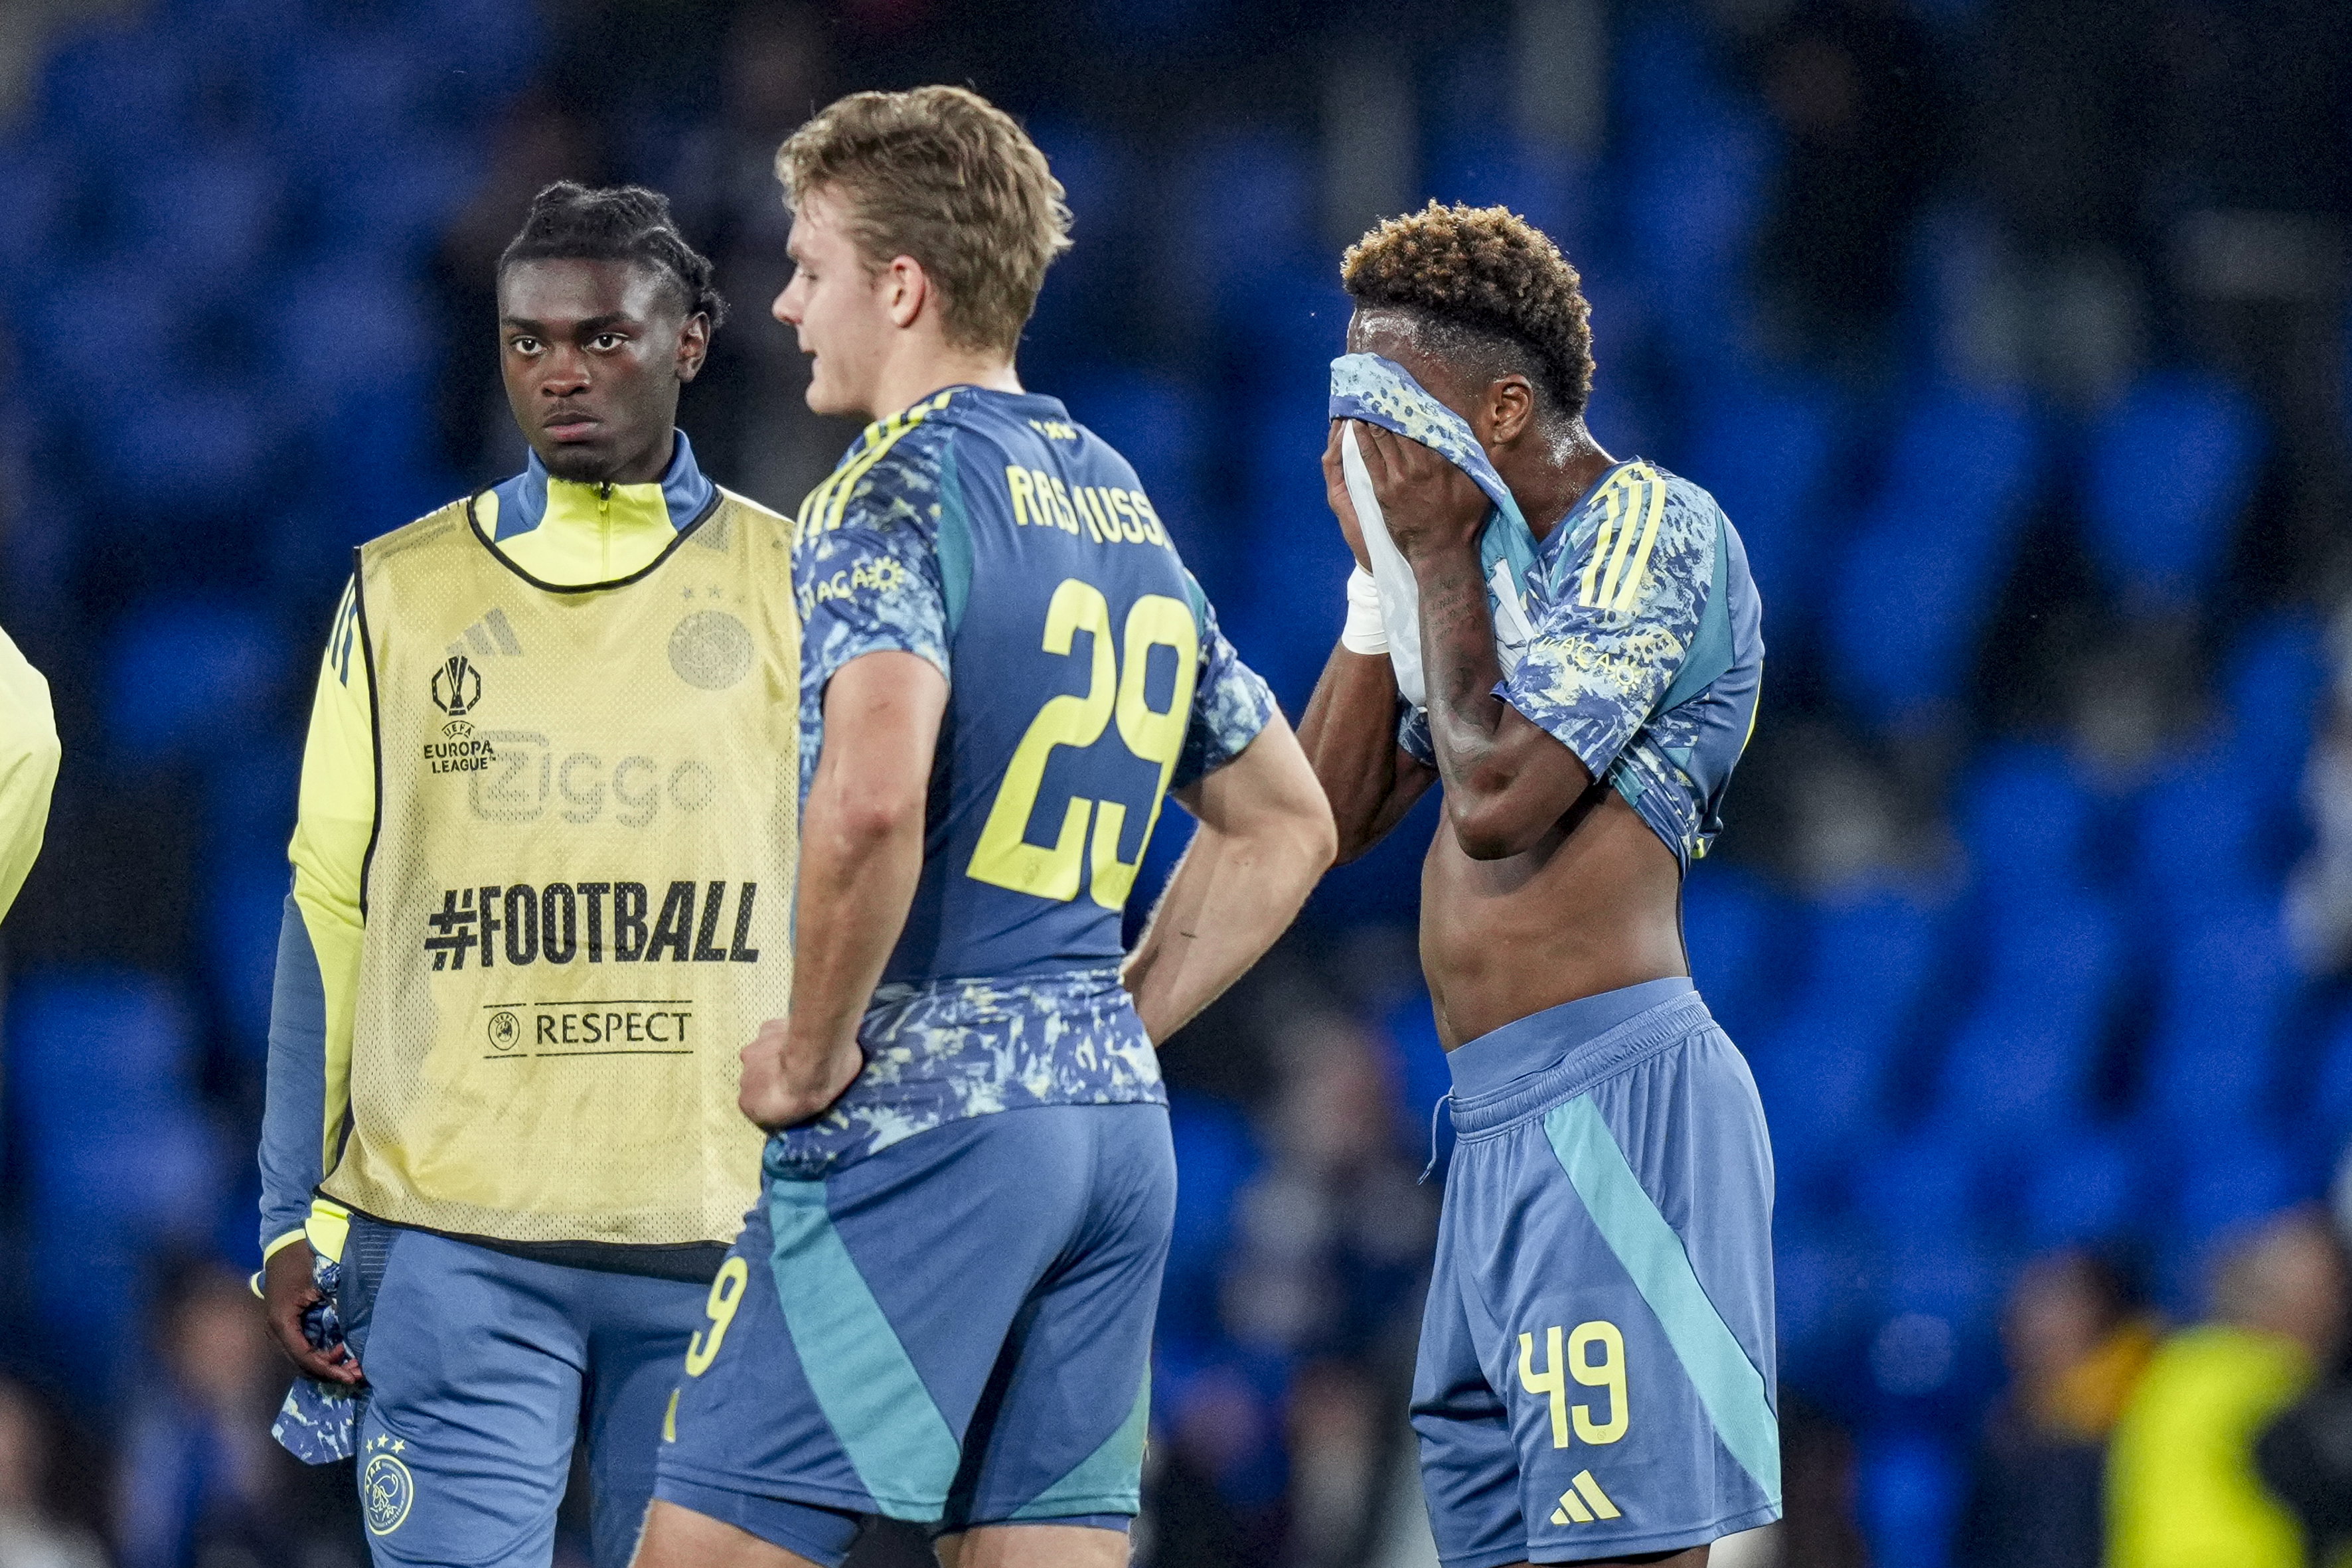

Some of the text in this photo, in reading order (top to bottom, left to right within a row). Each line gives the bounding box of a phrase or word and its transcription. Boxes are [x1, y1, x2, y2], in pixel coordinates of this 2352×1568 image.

[423, 740, 494, 759] EUROPA
[443, 723, 472, 737] UEFA
[966, 578, 1198, 912] 29
[424, 880, 760, 971] #FOOTBALL
[536, 1012, 692, 1044] RESPECT
[1518, 1320, 1629, 1449] 49
